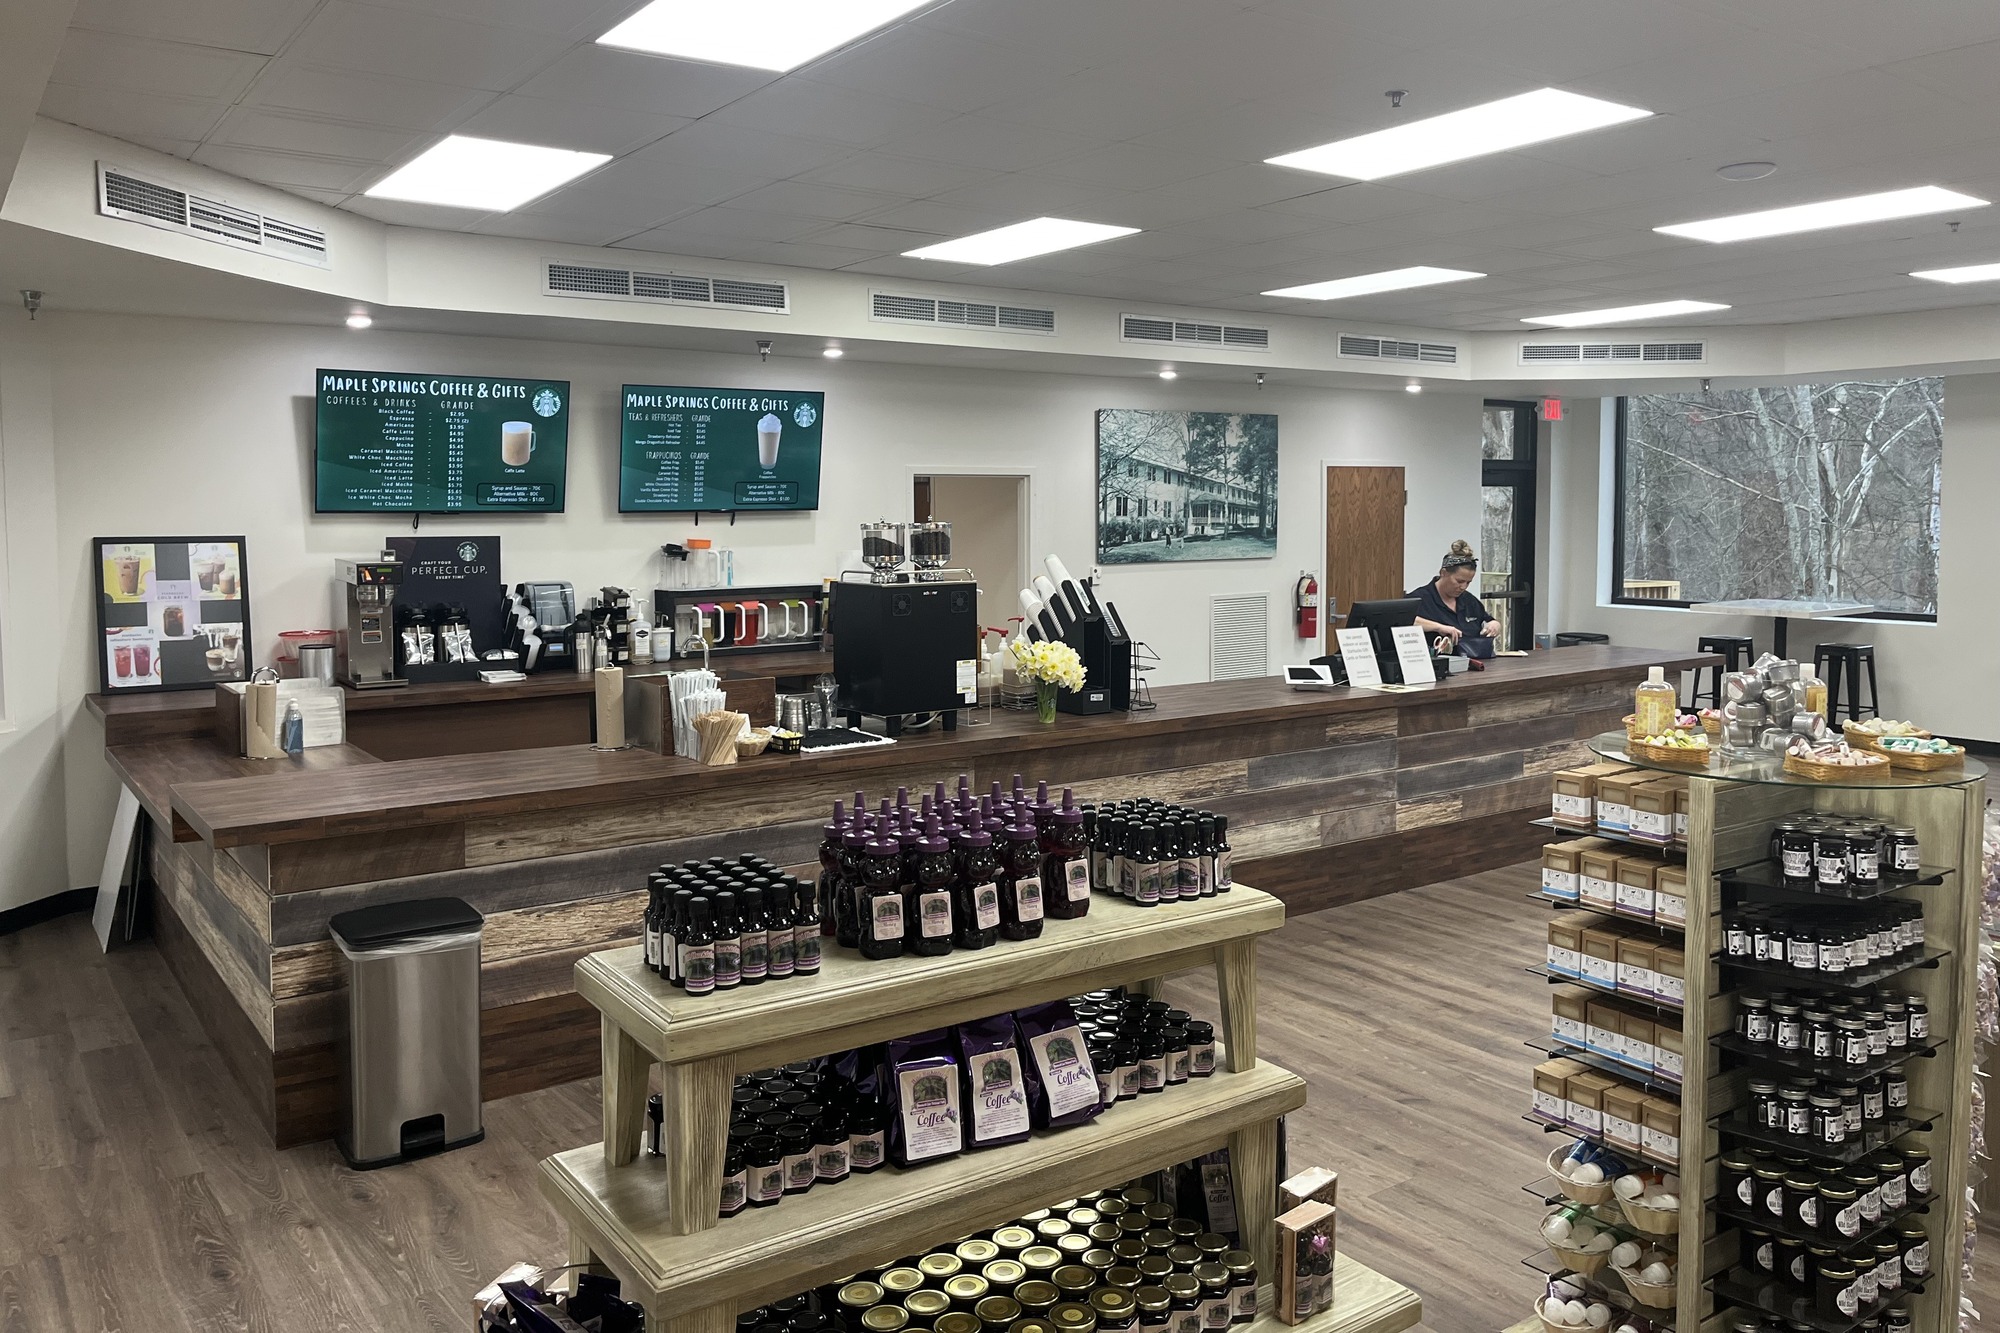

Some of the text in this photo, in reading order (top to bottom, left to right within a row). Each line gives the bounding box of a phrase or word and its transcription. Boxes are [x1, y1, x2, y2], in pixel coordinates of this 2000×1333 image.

[322, 376, 368, 391] MAPLE
[371, 377, 426, 394] SPRINGS
[429, 380, 473, 396] COFFEE
[477, 383, 489, 398] &
[492, 383, 526, 398] GIFTS
[326, 395, 417, 407] COFFEES & DRINKS
[440, 400, 474, 410] GRANDE
[626, 394, 789, 411] MAPLE SPRINGS COFFEE & GIFTS
[1545, 400, 1562, 420] EXIT
[628, 413, 643, 421] TEAS
[651, 413, 683, 422] REFRESHERS
[691, 414, 711, 422] GRANDE
[411, 566, 487, 575] PERFECT CUP,
[1057, 1071, 1080, 1085] Coffee
[986, 1094, 1011, 1109] Coffee
[917, 1113, 945, 1127] Coffee
[1209, 1194, 1229, 1203] Coffee
